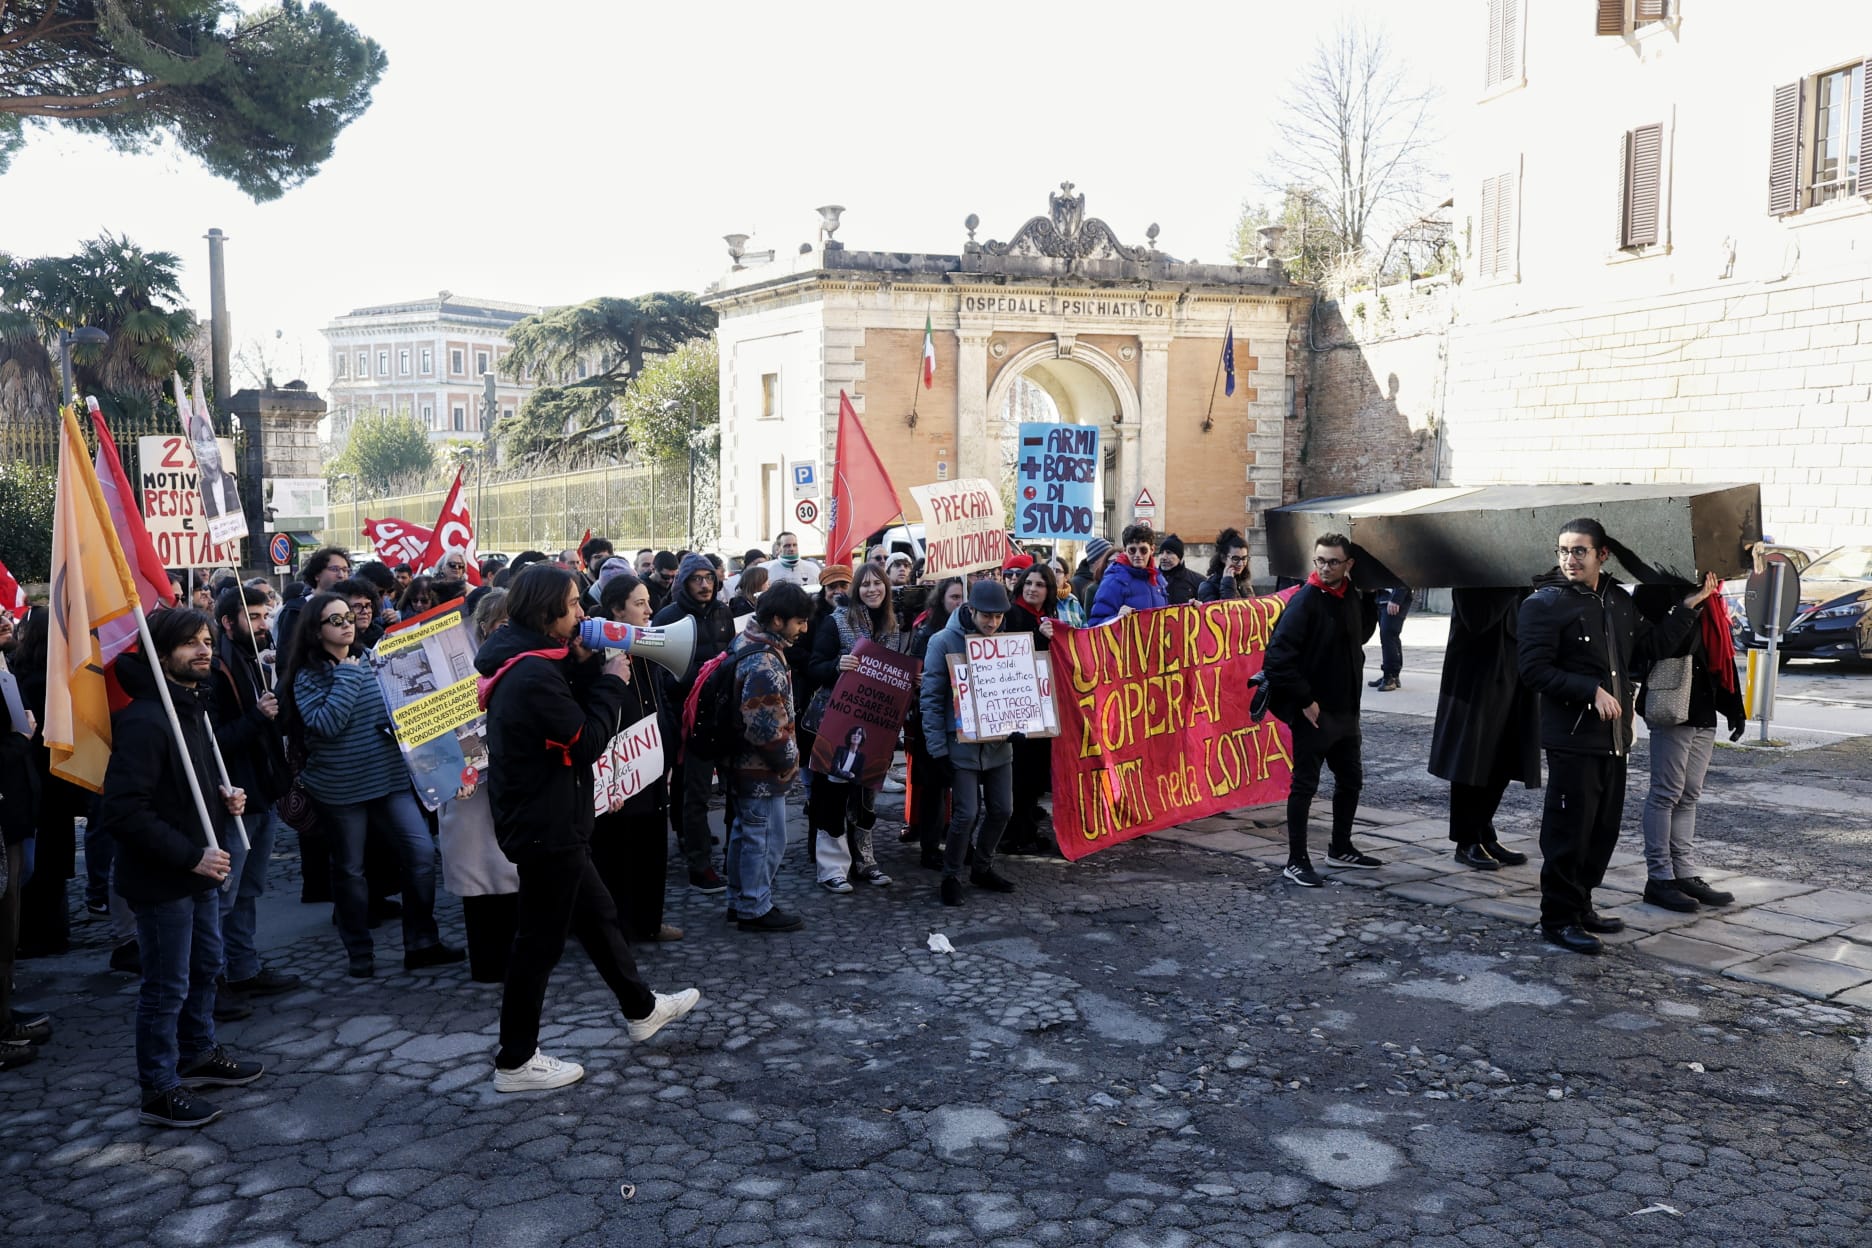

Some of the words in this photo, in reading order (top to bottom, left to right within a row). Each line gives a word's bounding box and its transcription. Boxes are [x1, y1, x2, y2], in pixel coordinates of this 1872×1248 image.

[966, 296, 1046, 313] OSPEDALE
[1062, 301, 1163, 318] PSICHIATRICO
[1047, 428, 1095, 455] ARMI
[797, 468, 809, 483] P
[1043, 454, 1095, 483] BORSE
[1047, 483, 1064, 503] DI
[800, 506, 814, 518] 30
[931, 491, 993, 525] PRECARI
[1022, 503, 1093, 534] STUDIO
[182, 518, 194, 530] E
[926, 528, 1005, 574] RIVOLUZIONARI
[969, 638, 1005, 661] DDL
[854, 664, 912, 692] ICERCATORE?
[860, 654, 882, 669] VUOI
[883, 663, 903, 678] FARE
[903, 671, 911, 681] IL
[857, 683, 895, 706] DOVRAI
[1002, 685, 1032, 696] ricerca
[455, 700, 473, 713] SONO
[829, 699, 852, 714] MIO
[840, 690, 883, 714] PASSARE
[883, 706, 899, 721] SUL
[1101, 666, 1223, 752] OPERAI
[597, 724, 659, 777] RNINI
[1156, 751, 1203, 812] nella
[1203, 721, 1295, 798] LOTTA
